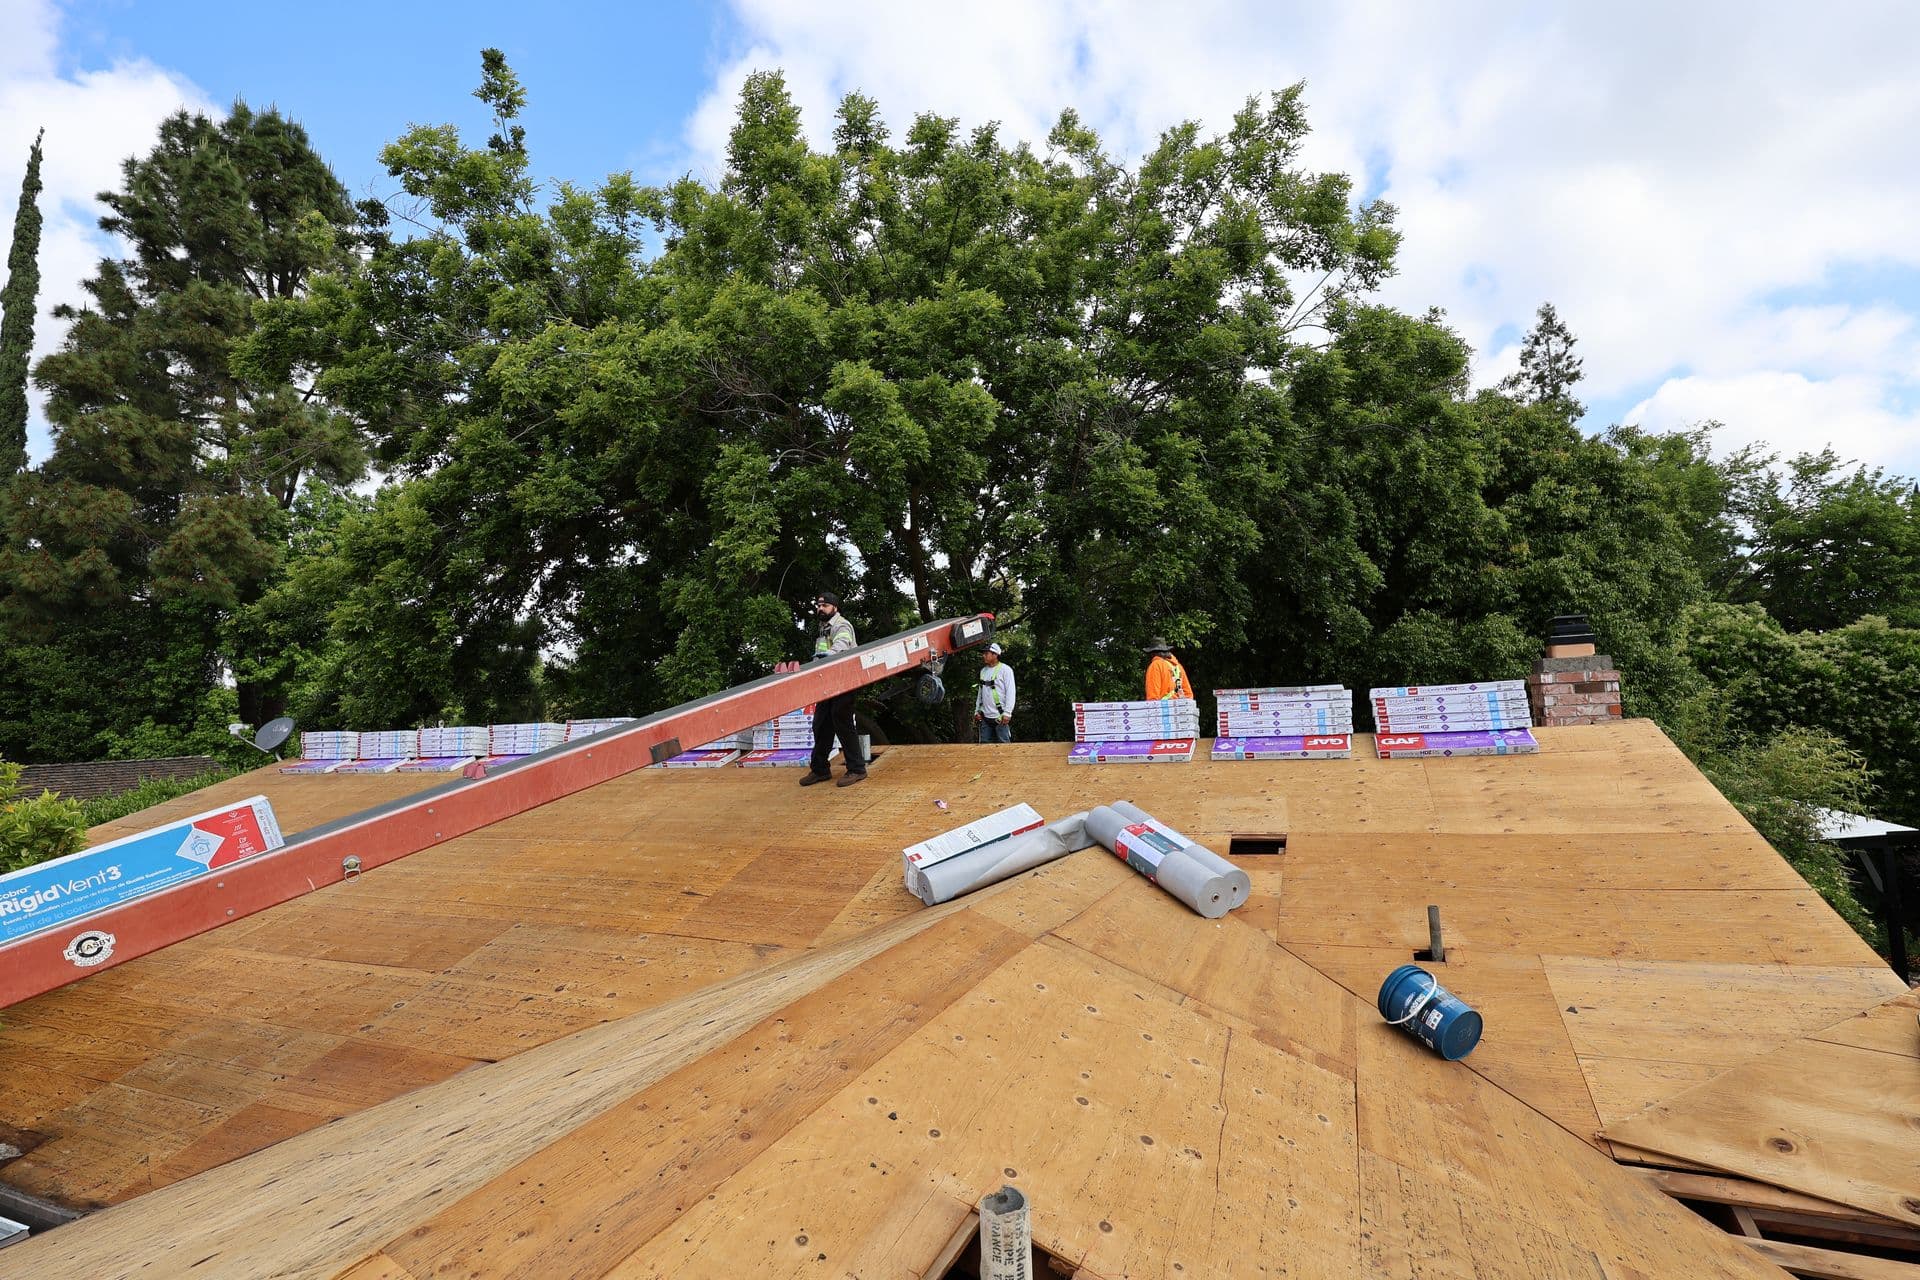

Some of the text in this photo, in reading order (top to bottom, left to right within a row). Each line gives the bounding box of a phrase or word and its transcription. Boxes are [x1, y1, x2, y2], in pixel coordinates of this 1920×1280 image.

[1307, 738, 1344, 746] GAF
[1381, 737, 1420, 745] GAF
[1154, 742, 1188, 750] GAF
